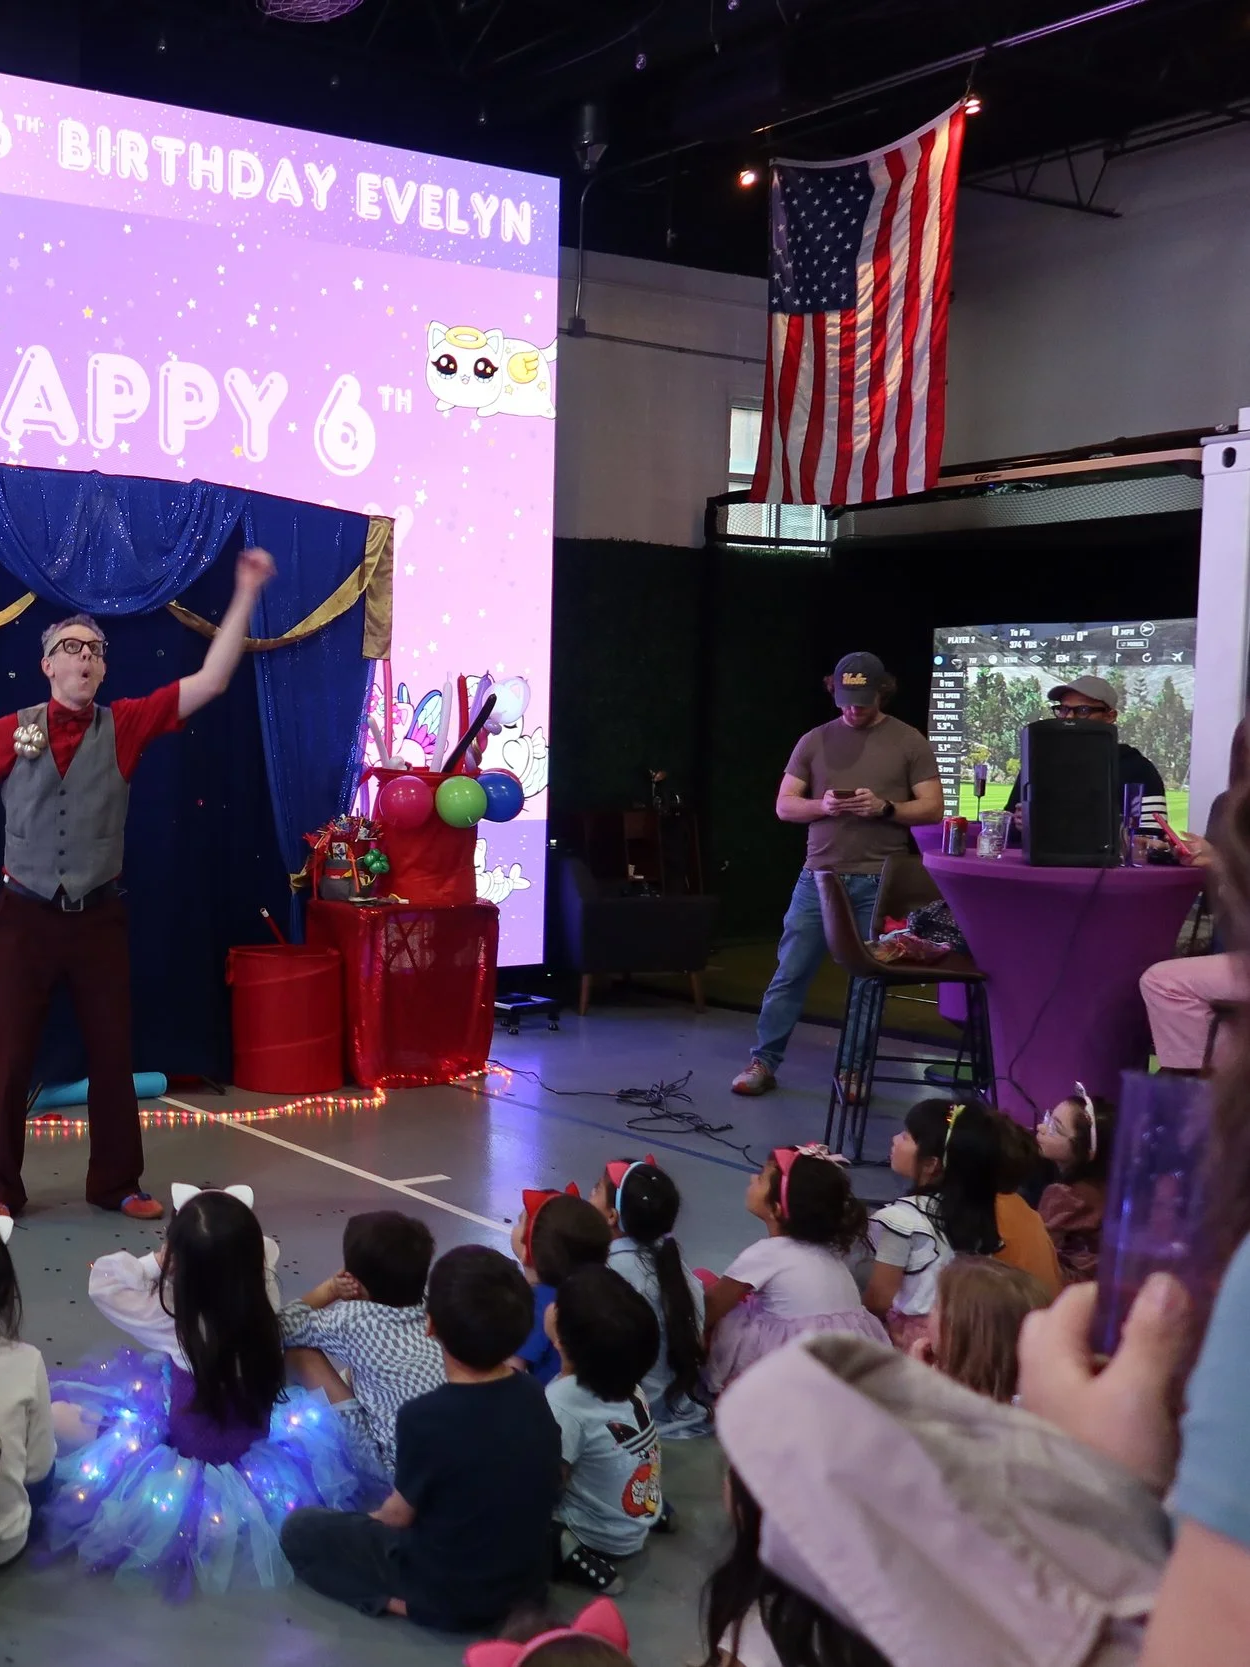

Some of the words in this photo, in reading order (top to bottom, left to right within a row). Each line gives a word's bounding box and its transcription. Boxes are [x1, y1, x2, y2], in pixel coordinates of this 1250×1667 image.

[57, 118, 336, 211] BIRTHDAY
[355, 171, 532, 245] EVELYN
[947, 636, 970, 644] PLAYER
